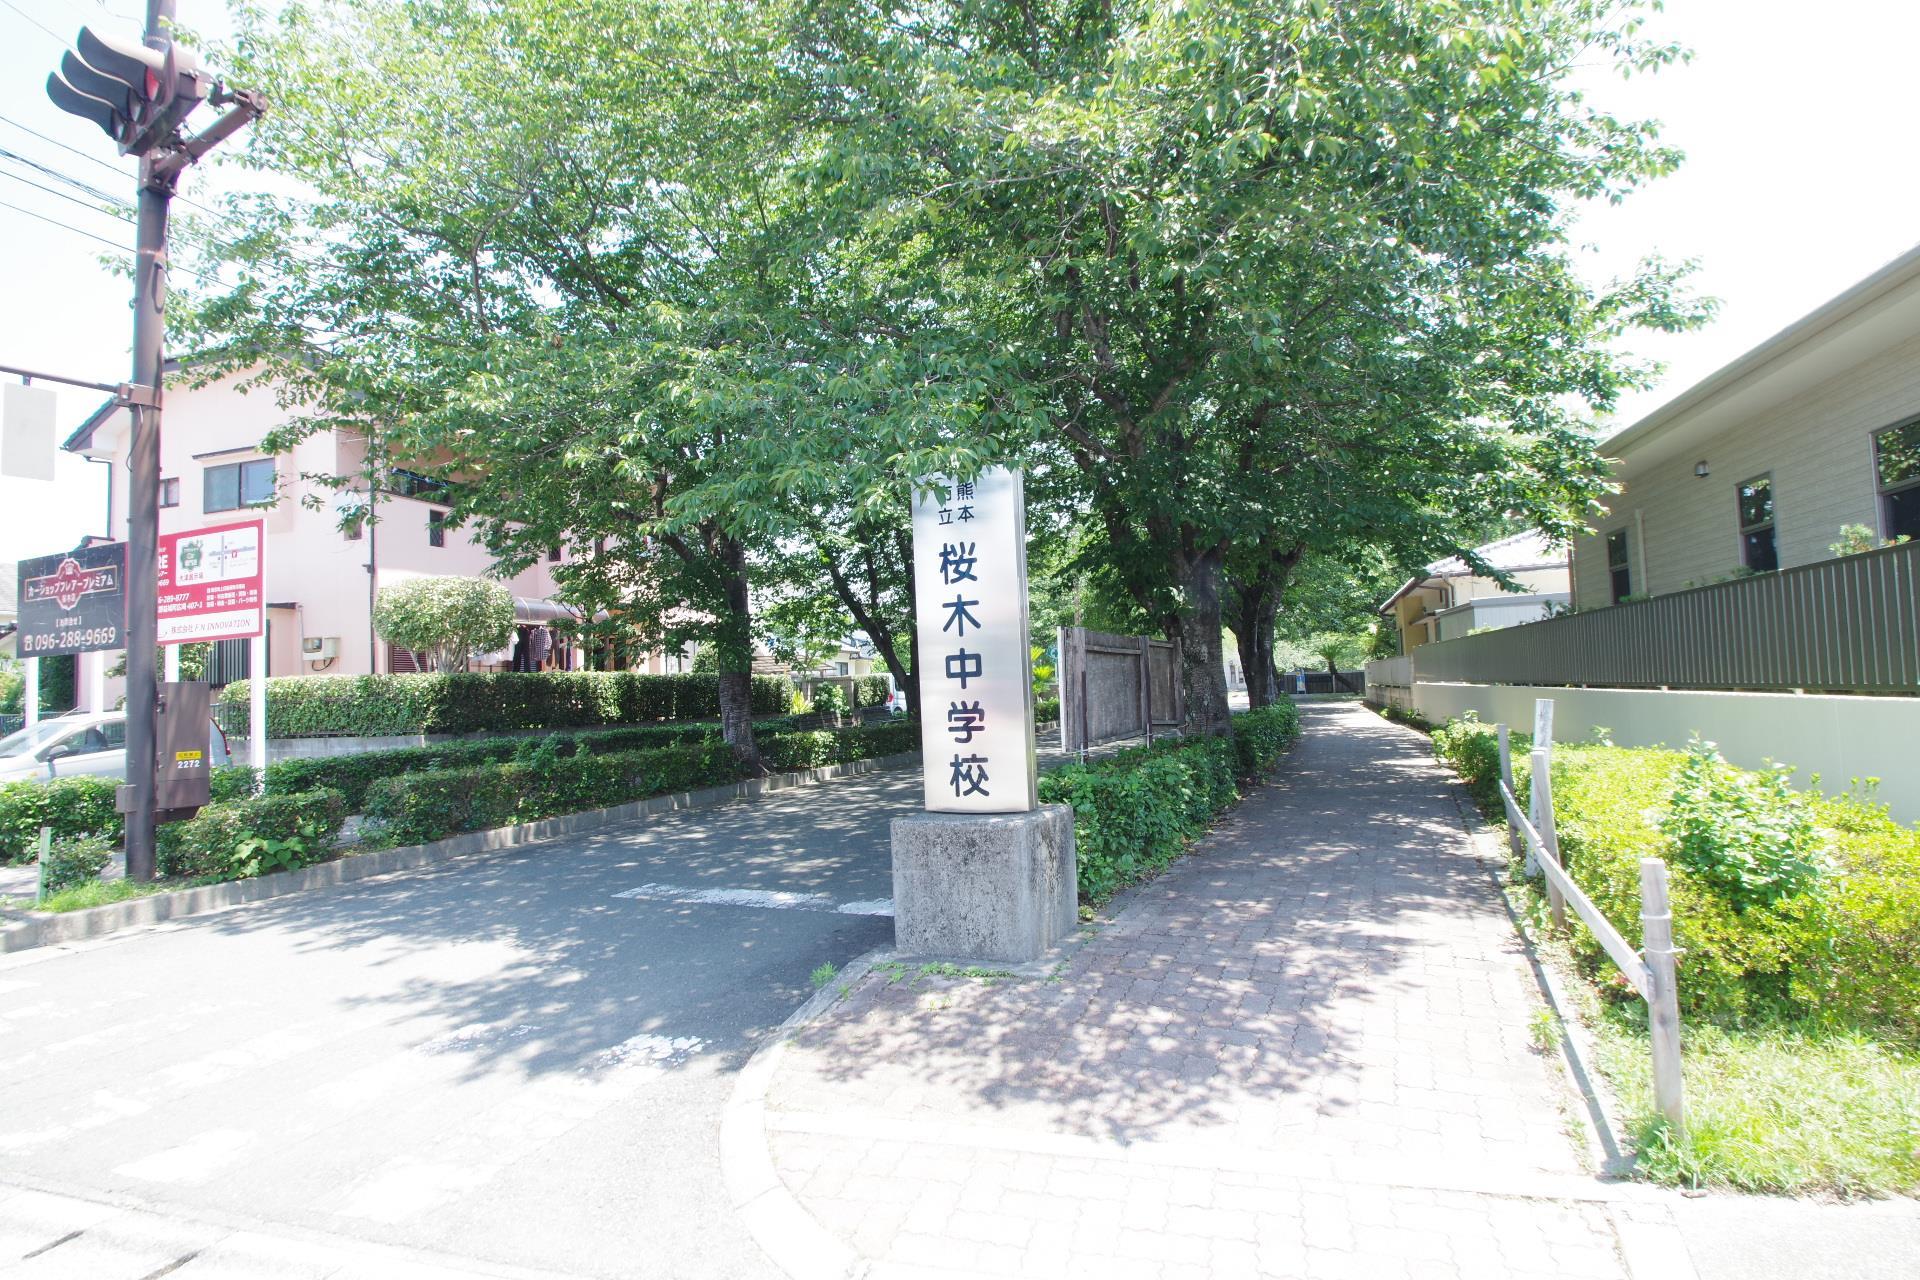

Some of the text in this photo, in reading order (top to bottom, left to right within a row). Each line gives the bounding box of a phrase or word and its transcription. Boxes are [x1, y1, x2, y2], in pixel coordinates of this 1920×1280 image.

[956, 482, 975, 523] 熊本
[207, 618, 251, 631] INNOVATION
[35, 627, 116, 650] 096-288-9669
[938, 541, 990, 797] 桜木中学校
[177, 760, 200, 768] 2272
